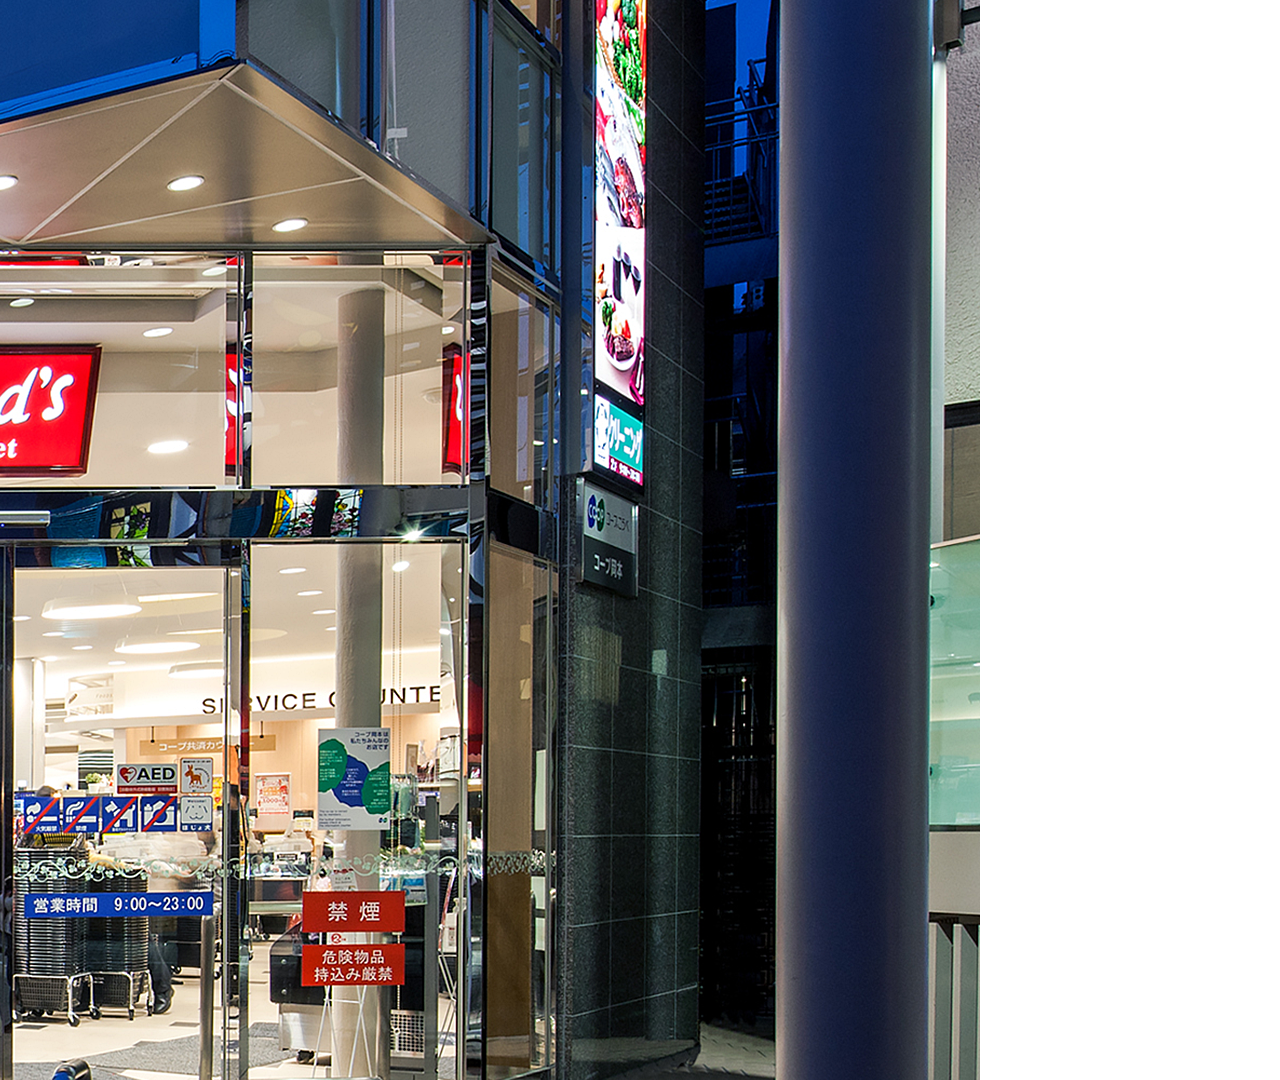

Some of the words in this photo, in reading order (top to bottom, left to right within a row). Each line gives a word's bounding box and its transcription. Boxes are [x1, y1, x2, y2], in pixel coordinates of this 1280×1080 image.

[202, 693, 316, 714] SVICE
[136, 767, 176, 780] AED
[33, 897, 98, 914] 営業時間
[321, 949, 385, 965] 危険物品
[314, 966, 393, 982] 持込み厳禁
